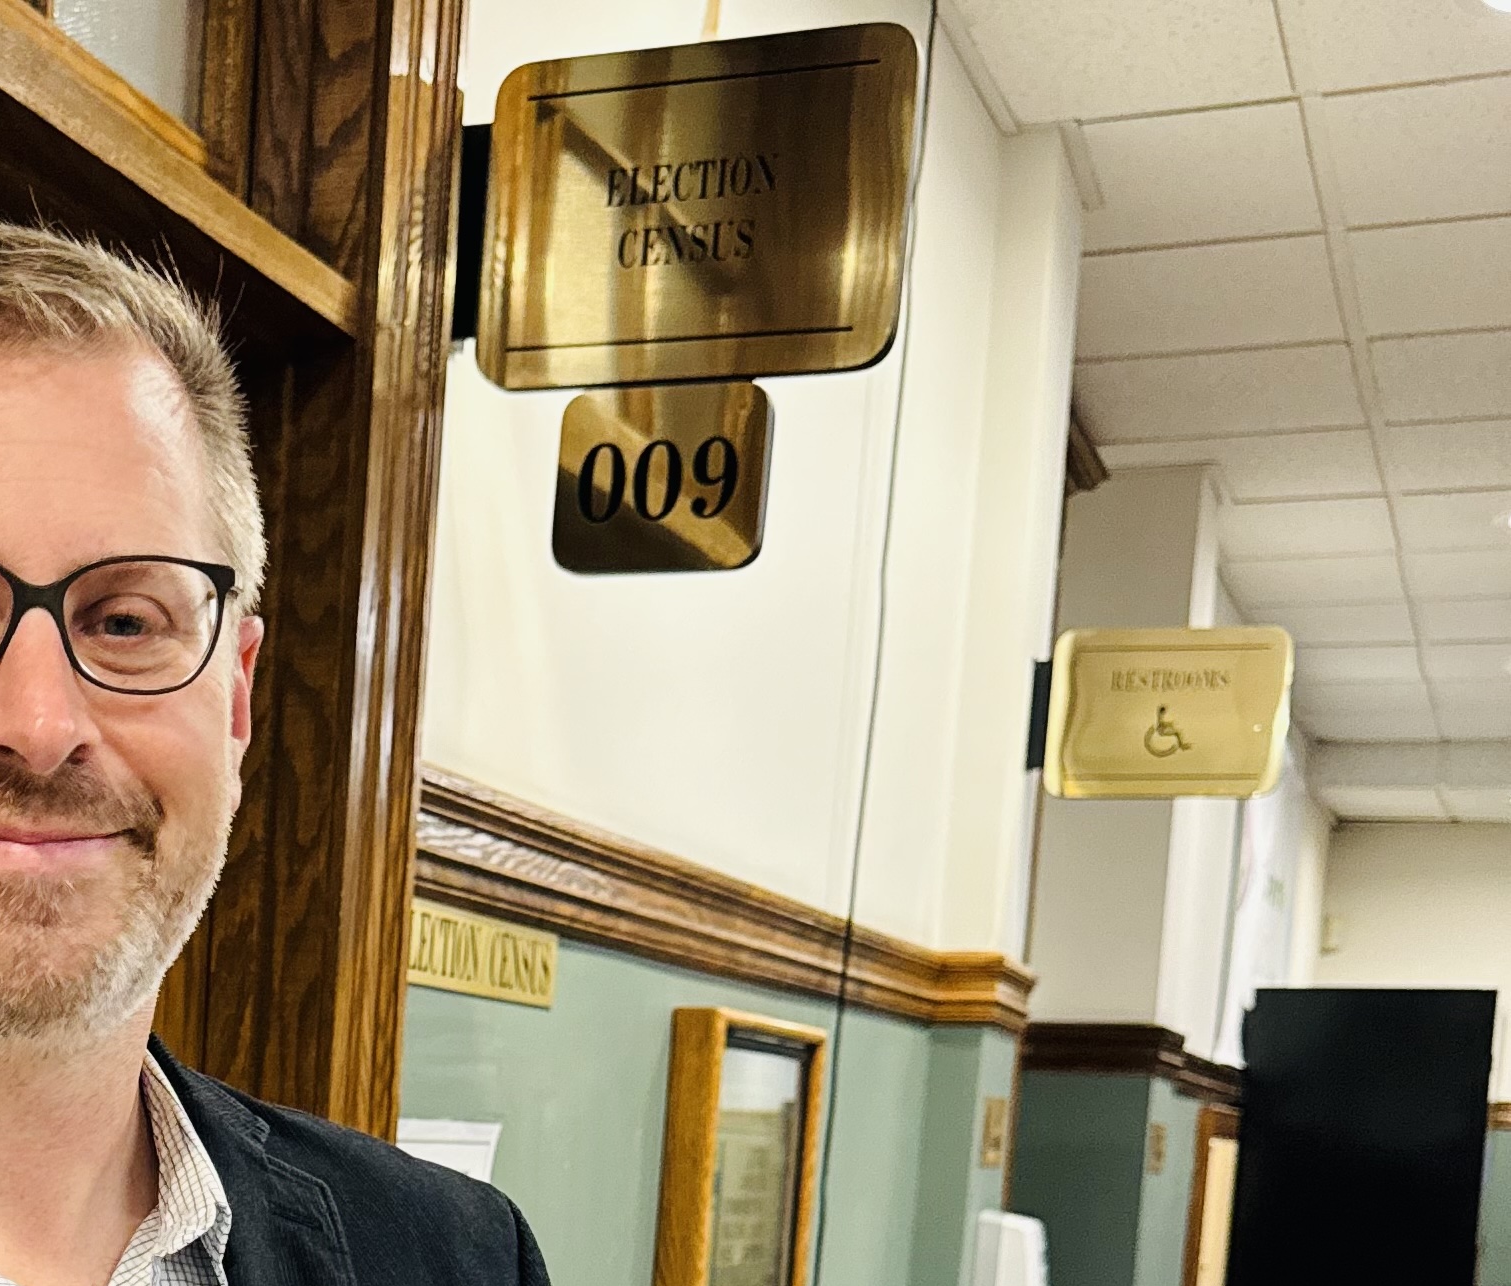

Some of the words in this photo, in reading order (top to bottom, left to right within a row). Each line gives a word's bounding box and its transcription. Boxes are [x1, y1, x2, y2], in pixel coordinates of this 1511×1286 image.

[606, 152, 778, 208] ELECTION
[618, 219, 756, 269] CENSUS
[578, 436, 738, 524] 009
[408, 910, 481, 983] LECTION
[489, 930, 553, 996] CENSUS
